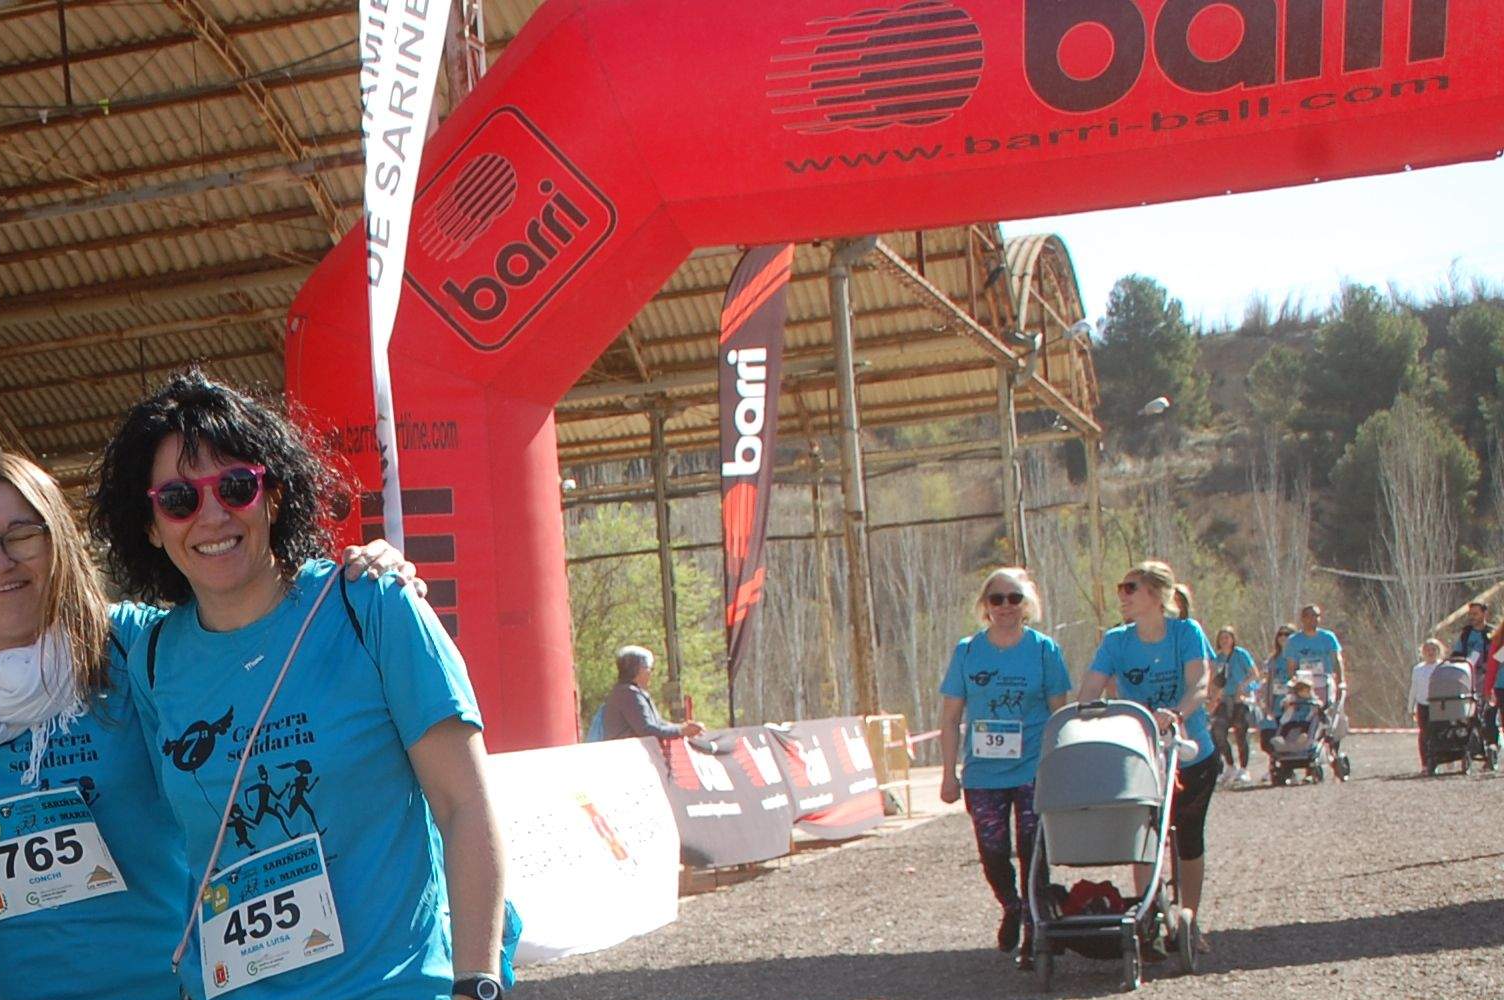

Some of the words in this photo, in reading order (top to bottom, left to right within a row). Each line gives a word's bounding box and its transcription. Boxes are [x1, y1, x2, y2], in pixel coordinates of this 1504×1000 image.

[785, 72, 1450, 174] www.barri-ball.com
[367, 211, 391, 288] DE
[440, 178, 590, 323] barri
[722, 347, 767, 477] barri
[28, 872, 63, 885] CONCHI
[279, 862, 319, 882] MARZO
[223, 890, 301, 946] 455
